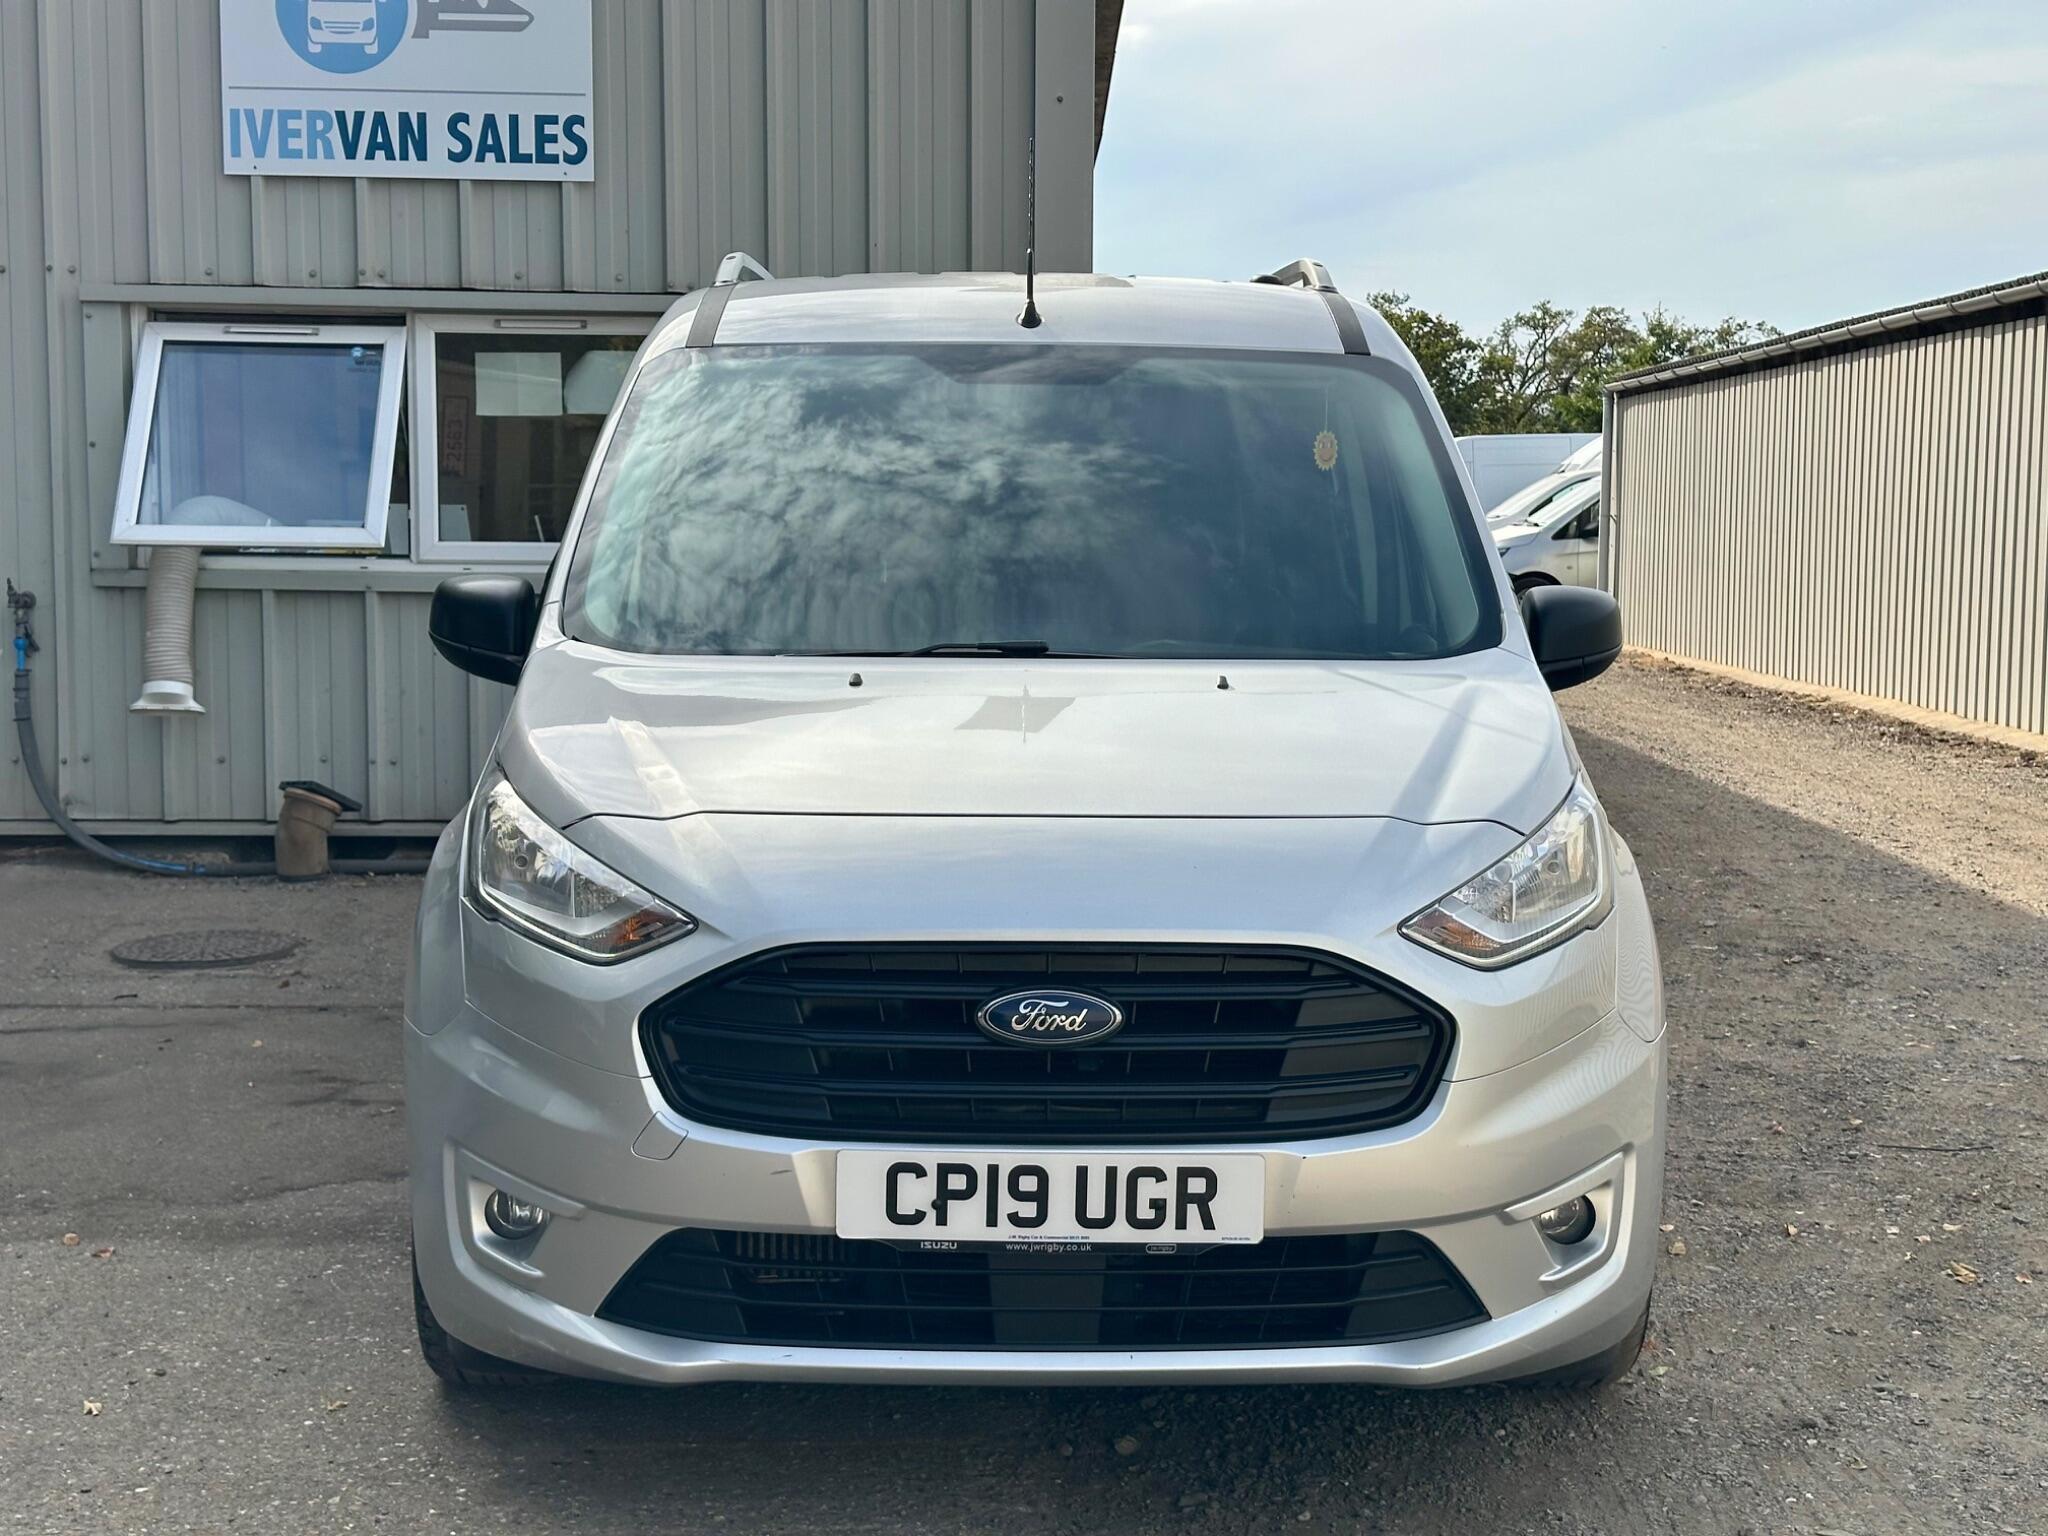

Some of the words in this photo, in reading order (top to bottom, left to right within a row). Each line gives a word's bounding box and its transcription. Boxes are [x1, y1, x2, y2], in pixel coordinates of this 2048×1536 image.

[229, 108, 428, 162] IVERVAN
[447, 111, 588, 165] SALES
[1011, 999, 1088, 1031] Ford
[885, 1161, 1050, 1229] CP19
[1074, 1165, 1218, 1231] UGR
[920, 1241, 957, 1249] ISUZU
[1005, 1243, 1092, 1253] www.jwrigby.co.uk
